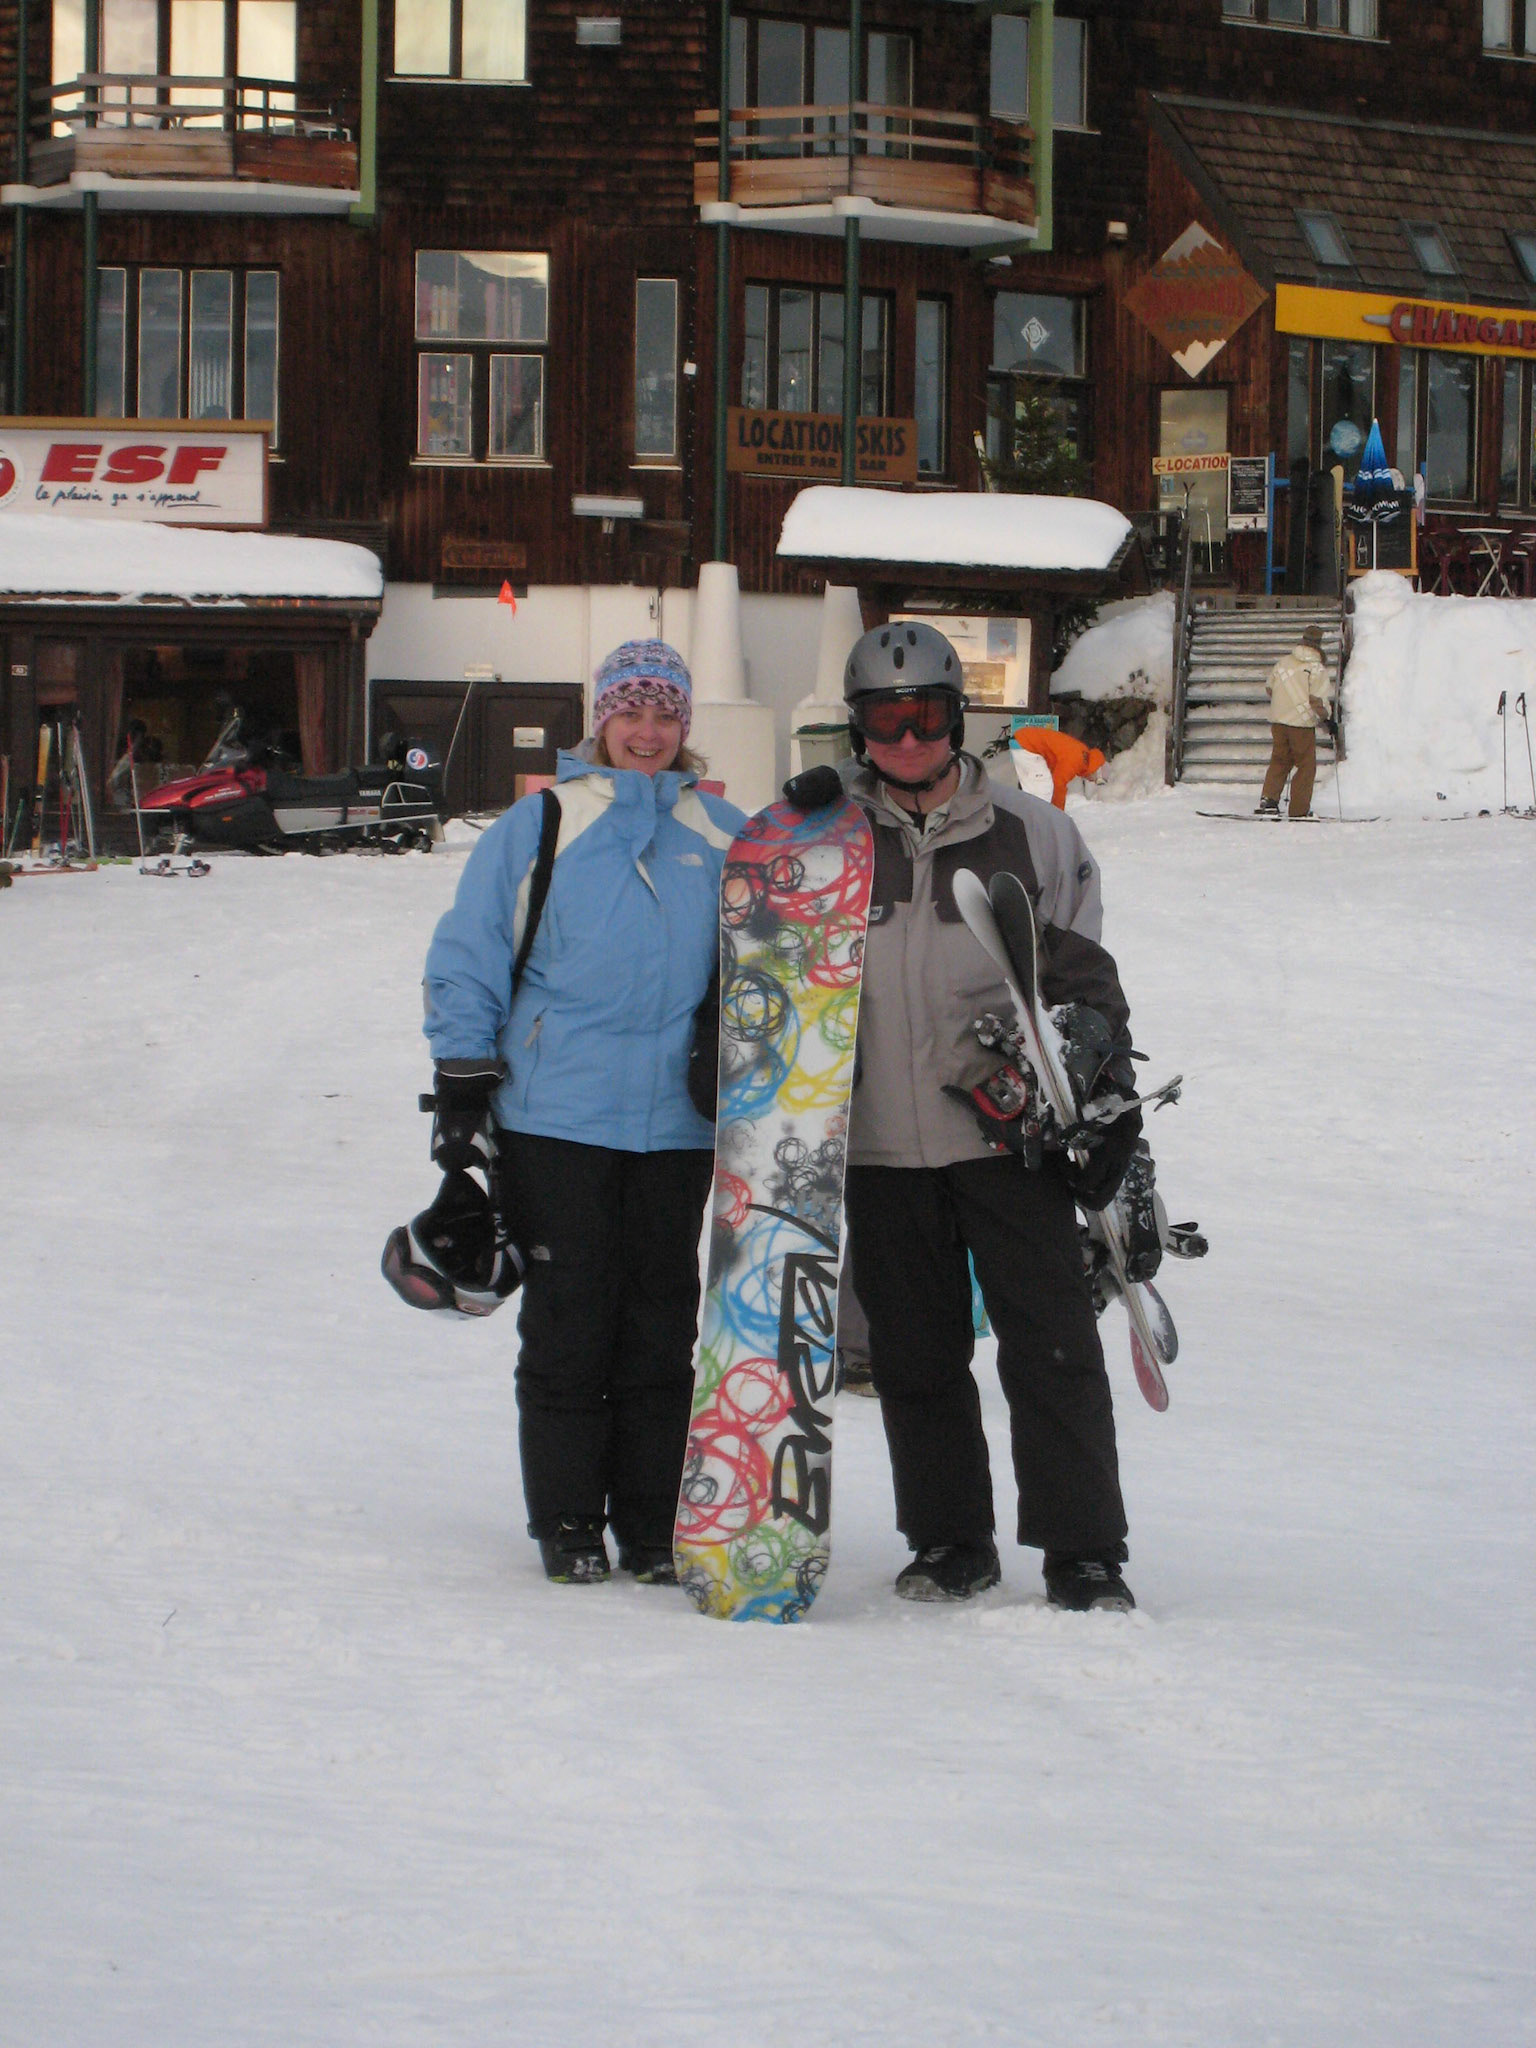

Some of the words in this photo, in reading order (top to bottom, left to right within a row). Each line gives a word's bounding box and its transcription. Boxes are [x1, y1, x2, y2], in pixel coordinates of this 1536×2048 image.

[857, 424, 906, 457] SKIS
[39, 443, 228, 484] ESF
[811, 456, 836, 468] PAR
[1167, 456, 1229, 472] LOCATION
